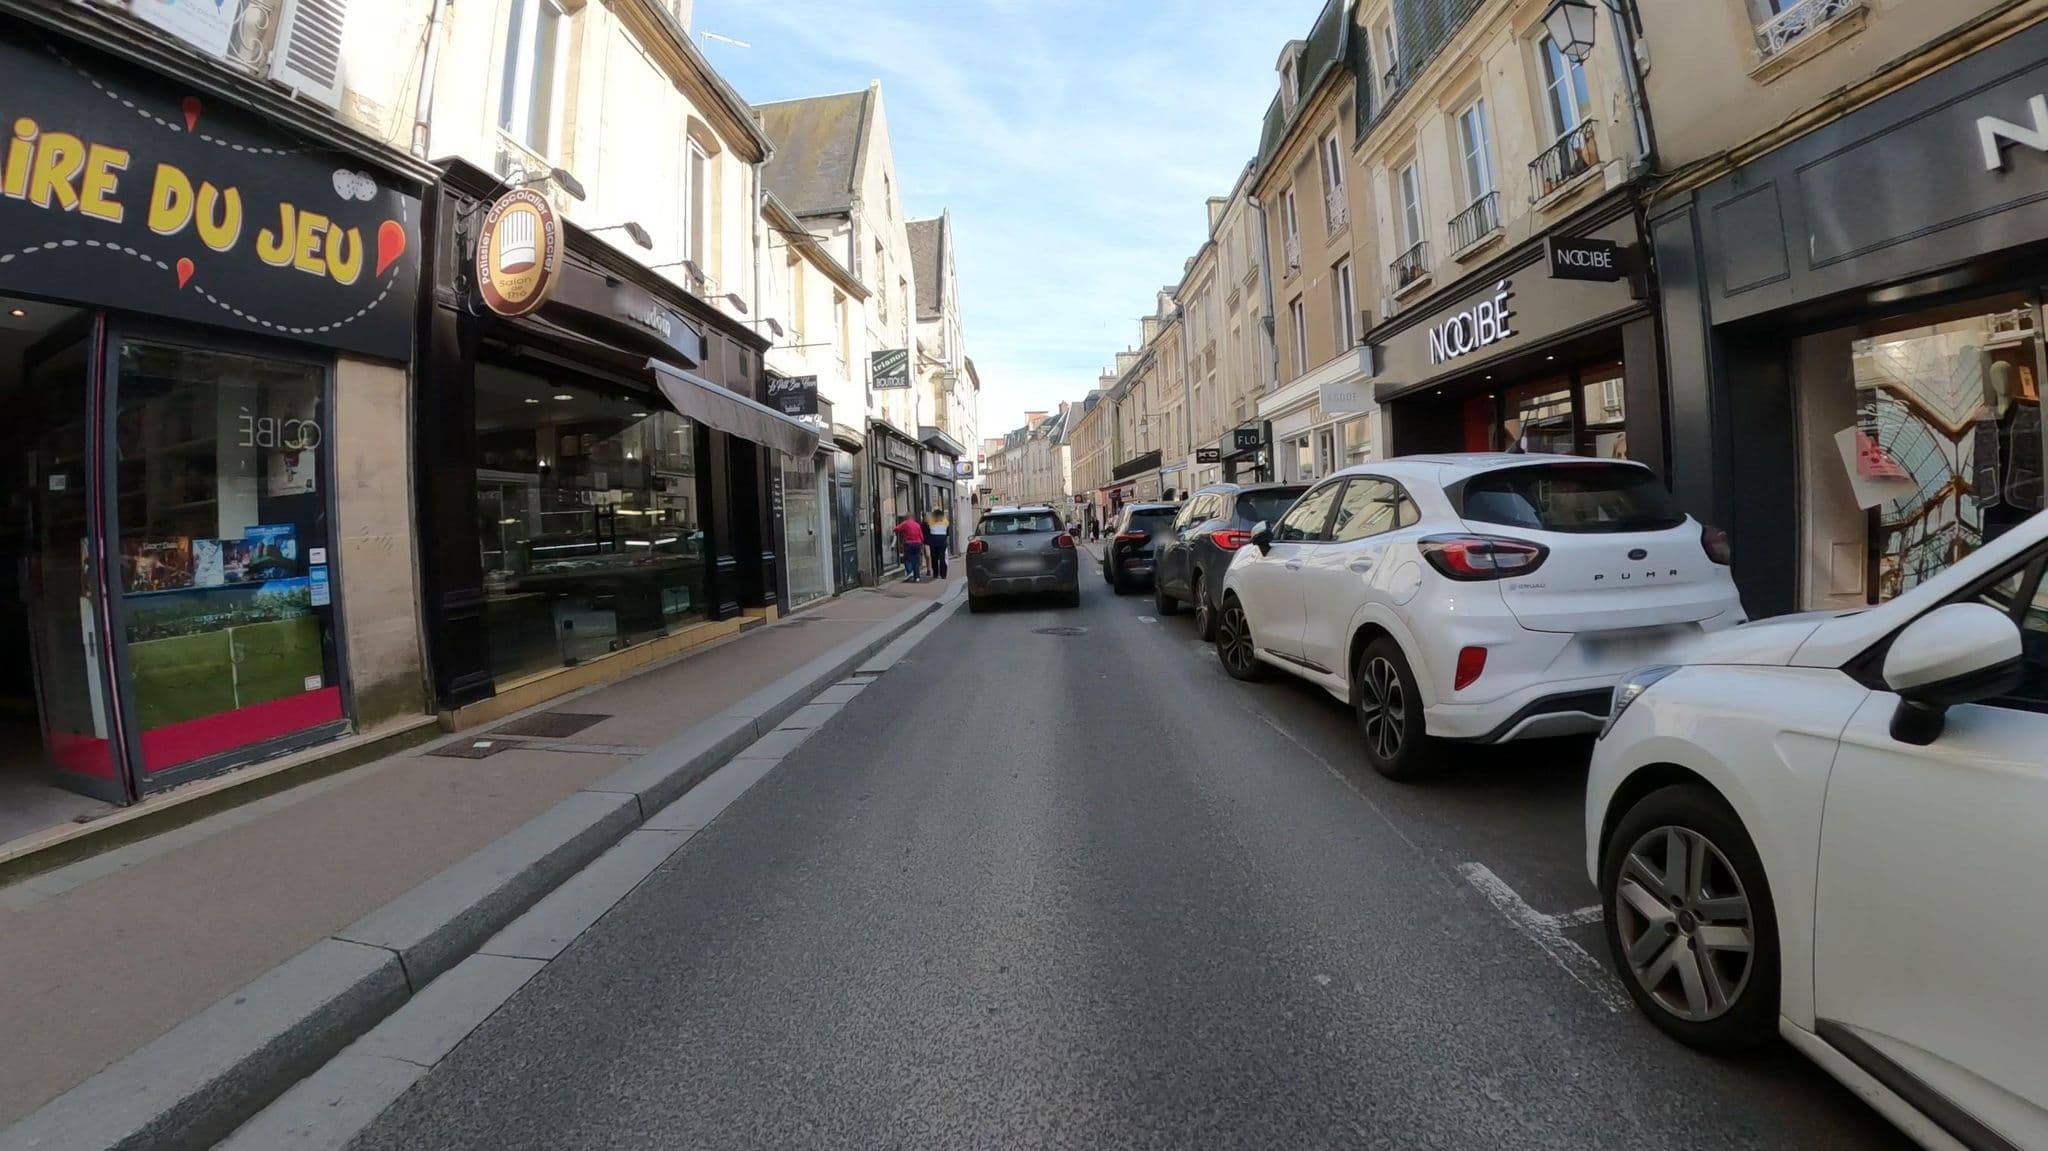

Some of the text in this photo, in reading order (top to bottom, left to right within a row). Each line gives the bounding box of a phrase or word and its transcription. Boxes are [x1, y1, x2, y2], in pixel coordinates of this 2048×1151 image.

[148, 163, 242, 252] DU
[256, 202, 363, 286] JEU
[488, 190, 549, 223] Chocolatier
[544, 220, 555, 273] Glacier
[1557, 249, 1613, 268] NOCIBÉ
[1429, 279, 1511, 365] NOCIBÉ
[873, 351, 906, 372] trianon
[876, 376, 905, 386] BOUTIQUE
[1237, 434, 1257, 445] FLO
[1594, 568, 1678, 581] PUMA
